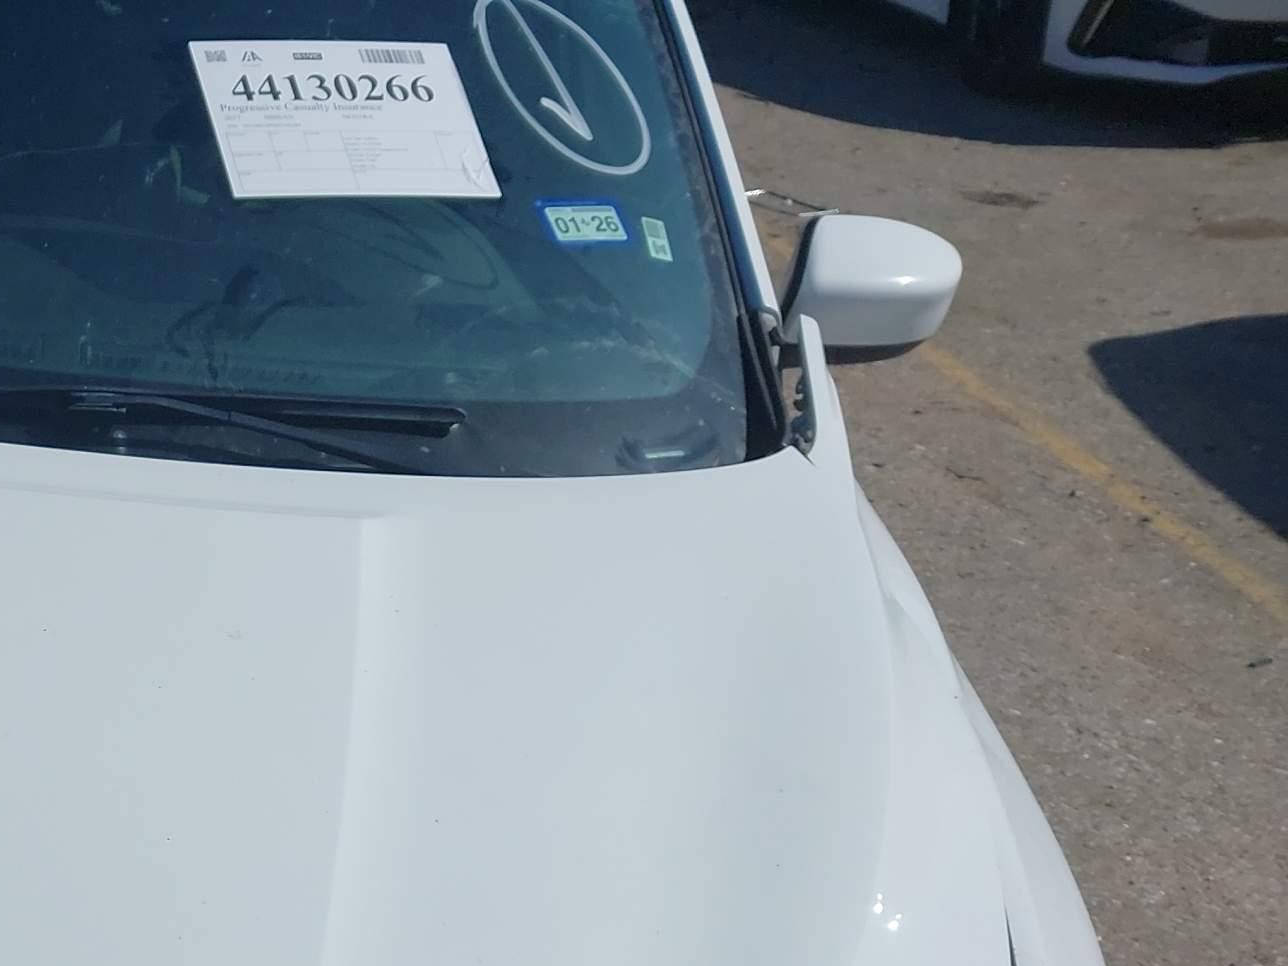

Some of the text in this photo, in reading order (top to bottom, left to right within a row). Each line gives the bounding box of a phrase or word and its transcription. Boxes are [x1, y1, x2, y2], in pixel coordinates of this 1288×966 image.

[231, 73, 435, 102] 44130266
[220, 103, 383, 113] Progressive Casualty Insurance
[591, 215, 620, 233] 26
